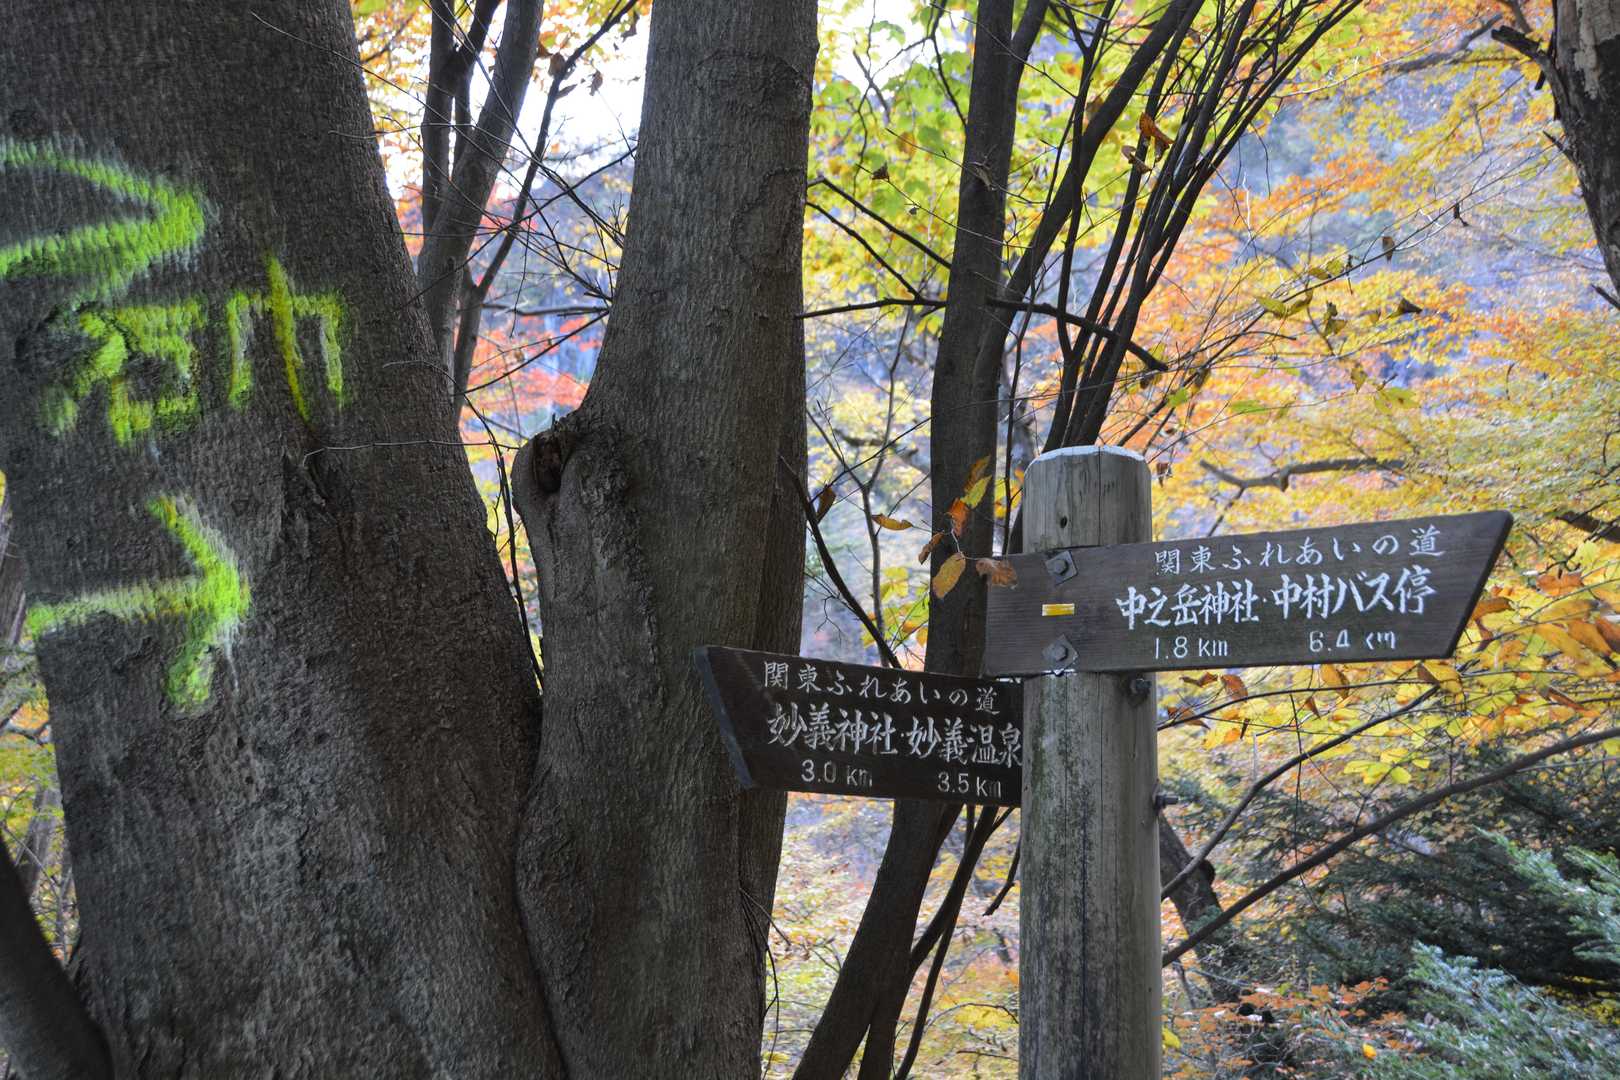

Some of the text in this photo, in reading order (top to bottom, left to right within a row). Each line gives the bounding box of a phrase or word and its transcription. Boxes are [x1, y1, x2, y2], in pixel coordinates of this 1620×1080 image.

[1153, 524, 1443, 575] 関東ふれあいの道
[1155, 635, 1188, 660] 1.8
[1198, 637, 1228, 657] km
[1309, 629, 1351, 653] 6.4
[764, 661, 1000, 715] 関東ふれあいの道
[801, 759, 1001, 798] 3.0 km 3.5 km
